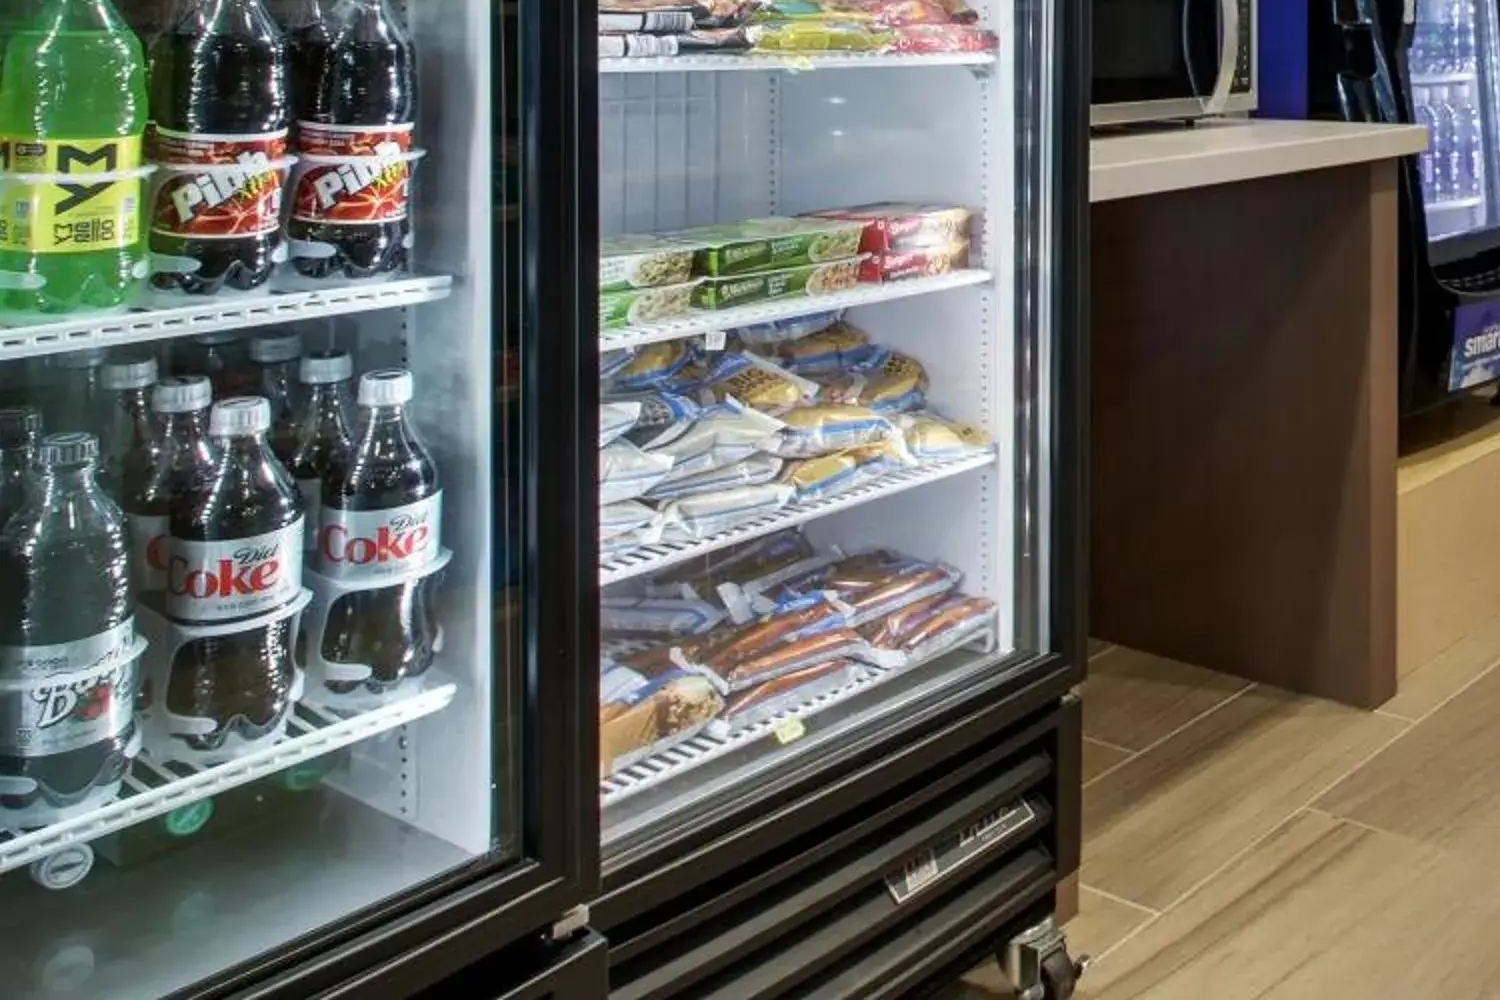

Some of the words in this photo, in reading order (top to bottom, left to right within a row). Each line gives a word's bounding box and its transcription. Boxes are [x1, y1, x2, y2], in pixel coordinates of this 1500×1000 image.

[388, 511, 429, 534] Diet
[232, 543, 279, 566] Diet
[317, 523, 429, 565] Coke
[169, 554, 280, 599] Coke
